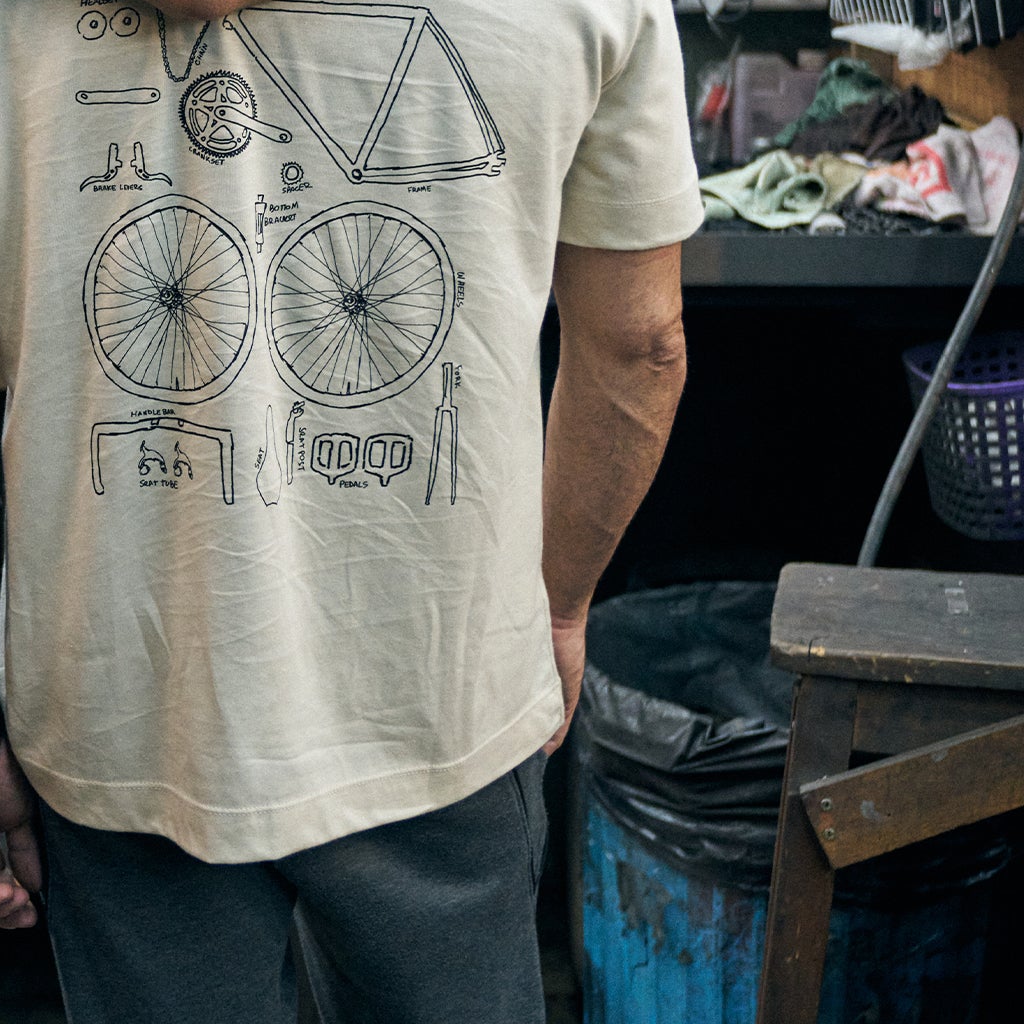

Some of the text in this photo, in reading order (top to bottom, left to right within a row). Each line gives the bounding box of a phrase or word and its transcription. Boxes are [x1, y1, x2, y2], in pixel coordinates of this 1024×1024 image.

[93, 184, 116, 192] BRAKE
[282, 182, 313, 194] SPACER
[407, 185, 432, 193] FRAME
[269, 201, 299, 213] BOTTOM
[161, 480, 178, 489] TUBE
[339, 480, 368, 488] PEDALS
